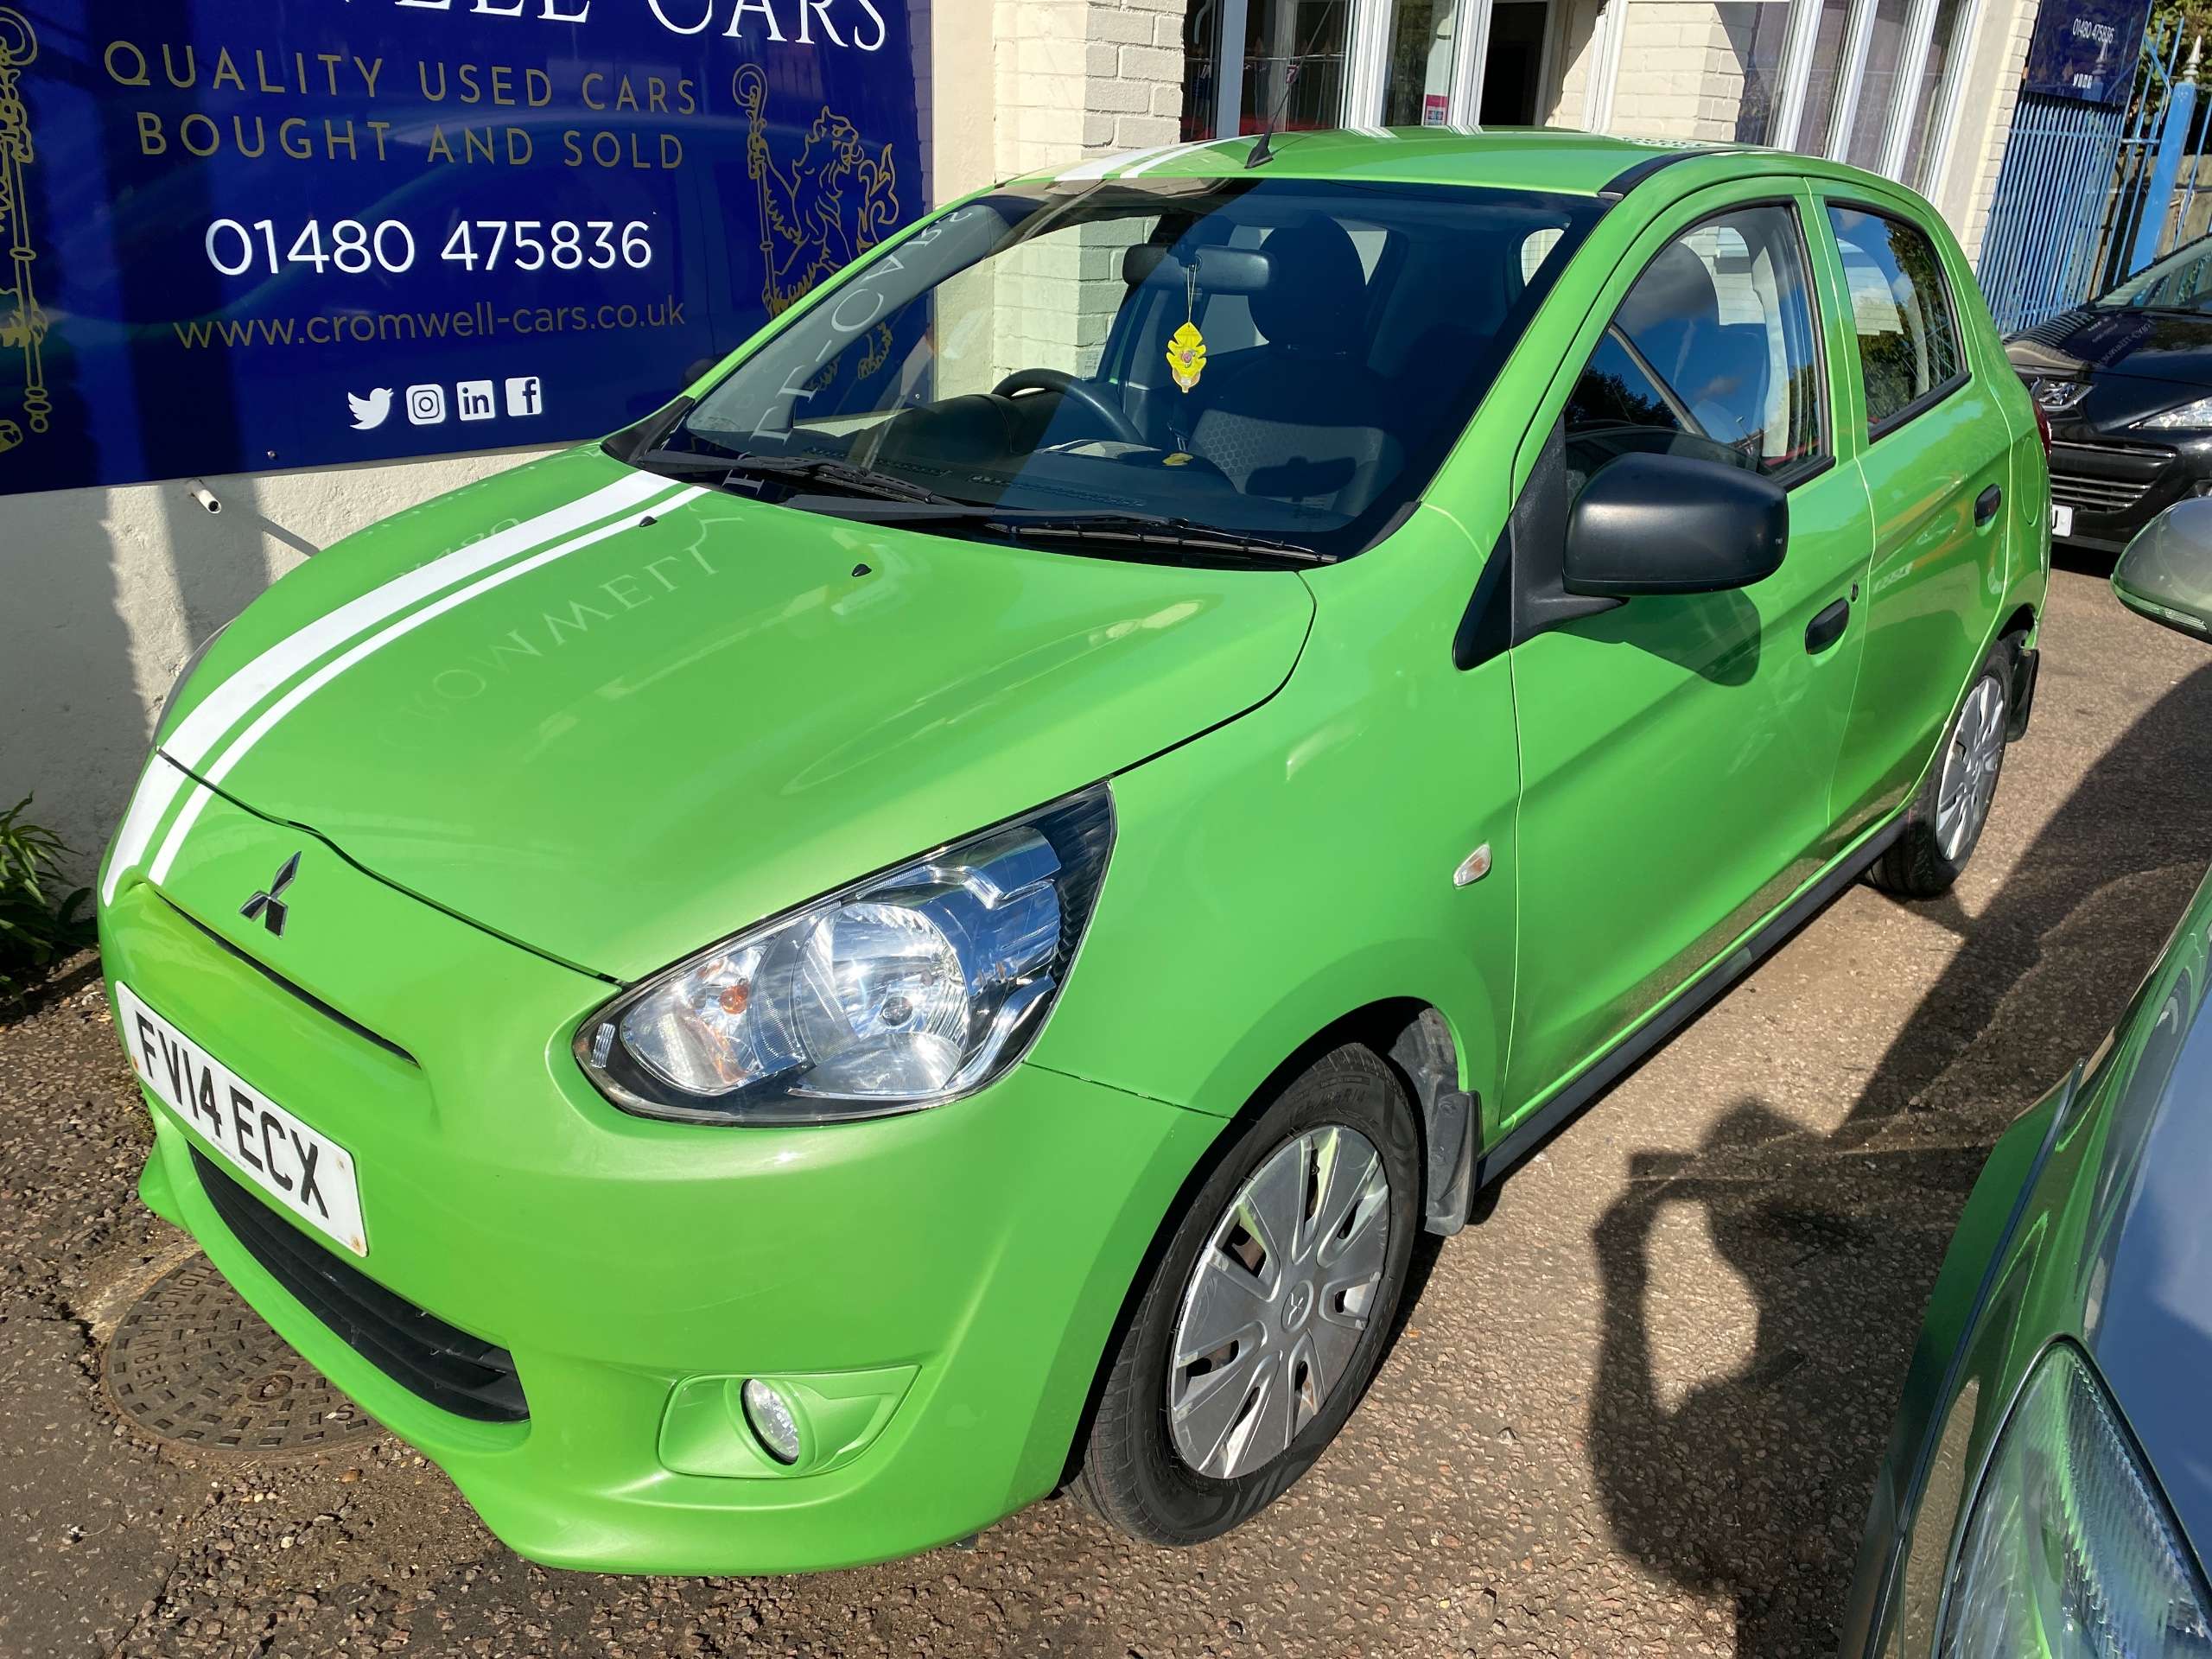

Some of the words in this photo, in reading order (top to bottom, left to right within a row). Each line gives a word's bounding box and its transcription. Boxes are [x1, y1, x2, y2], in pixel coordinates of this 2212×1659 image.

[2073, 17, 2092, 39] 01480
[104, 41, 383, 98] QUALITY
[419, 62, 553, 107] USED
[582, 73, 696, 115] CARS
[137, 111, 391, 160] BOUGHT
[427, 125, 533, 165] AND
[563, 130, 683, 168] SOLD
[205, 219, 416, 275] 01480
[441, 220, 652, 271] 475836
[174, 295, 685, 349] www.cromwell-cars.co.uk
[135, 1010, 222, 1140] FV14
[229, 1084, 329, 1220] ECX
[134, 1300, 179, 1391] CHAMBER
